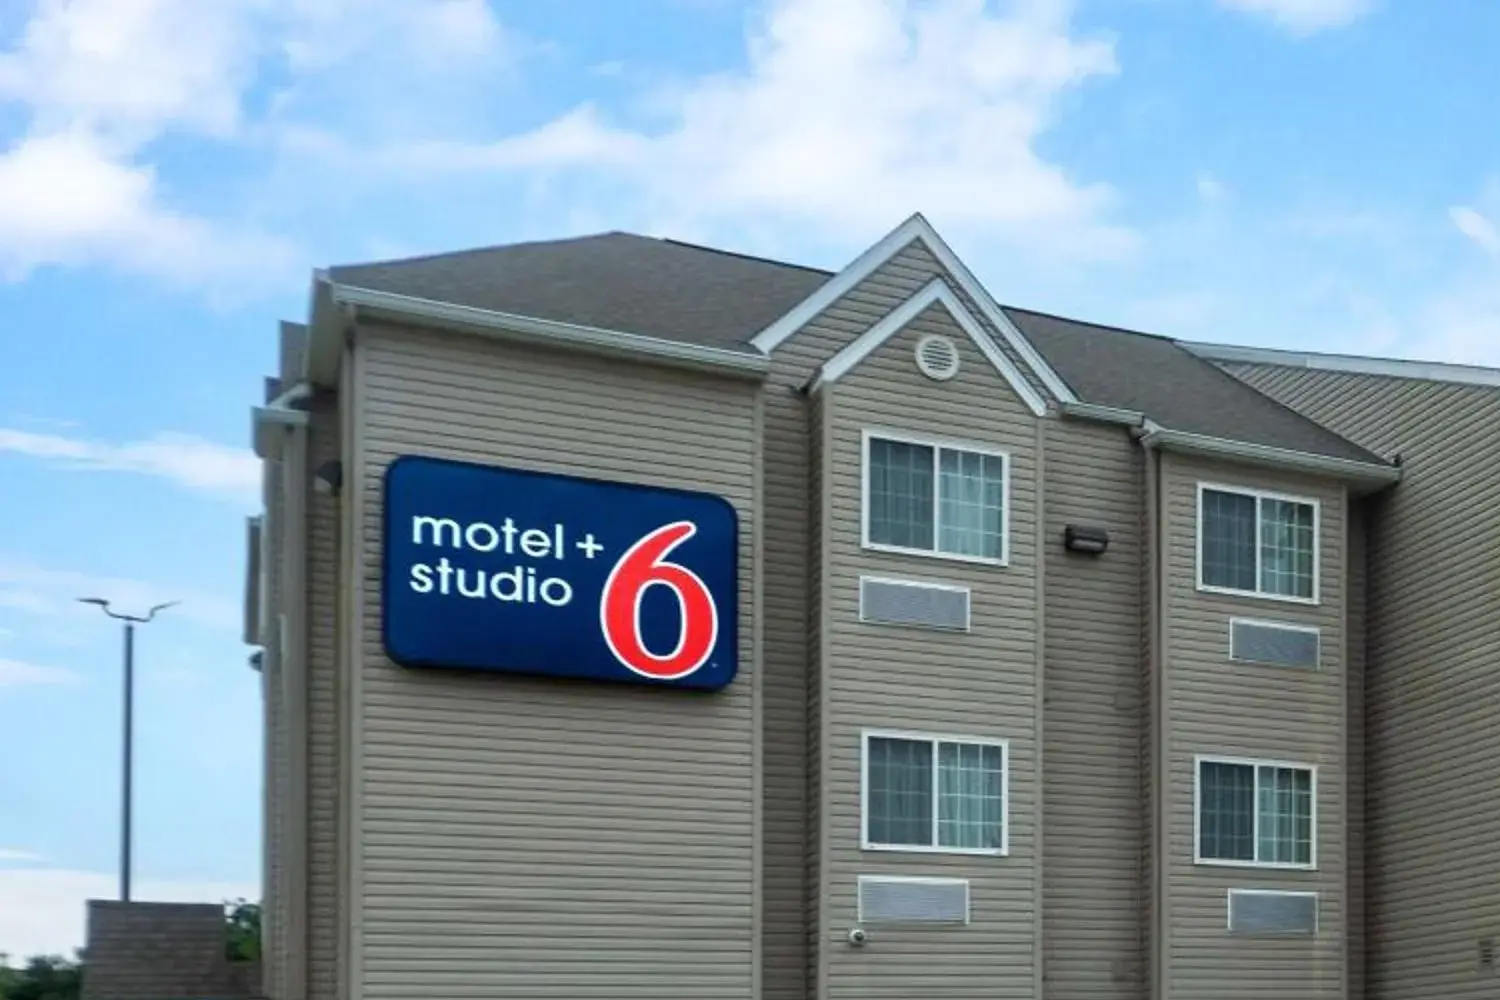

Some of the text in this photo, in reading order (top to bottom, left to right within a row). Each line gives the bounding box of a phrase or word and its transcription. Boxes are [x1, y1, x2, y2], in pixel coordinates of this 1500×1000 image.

[412, 515, 565, 560] motel
[409, 557, 574, 607] studio
[600, 520, 719, 680] 6
